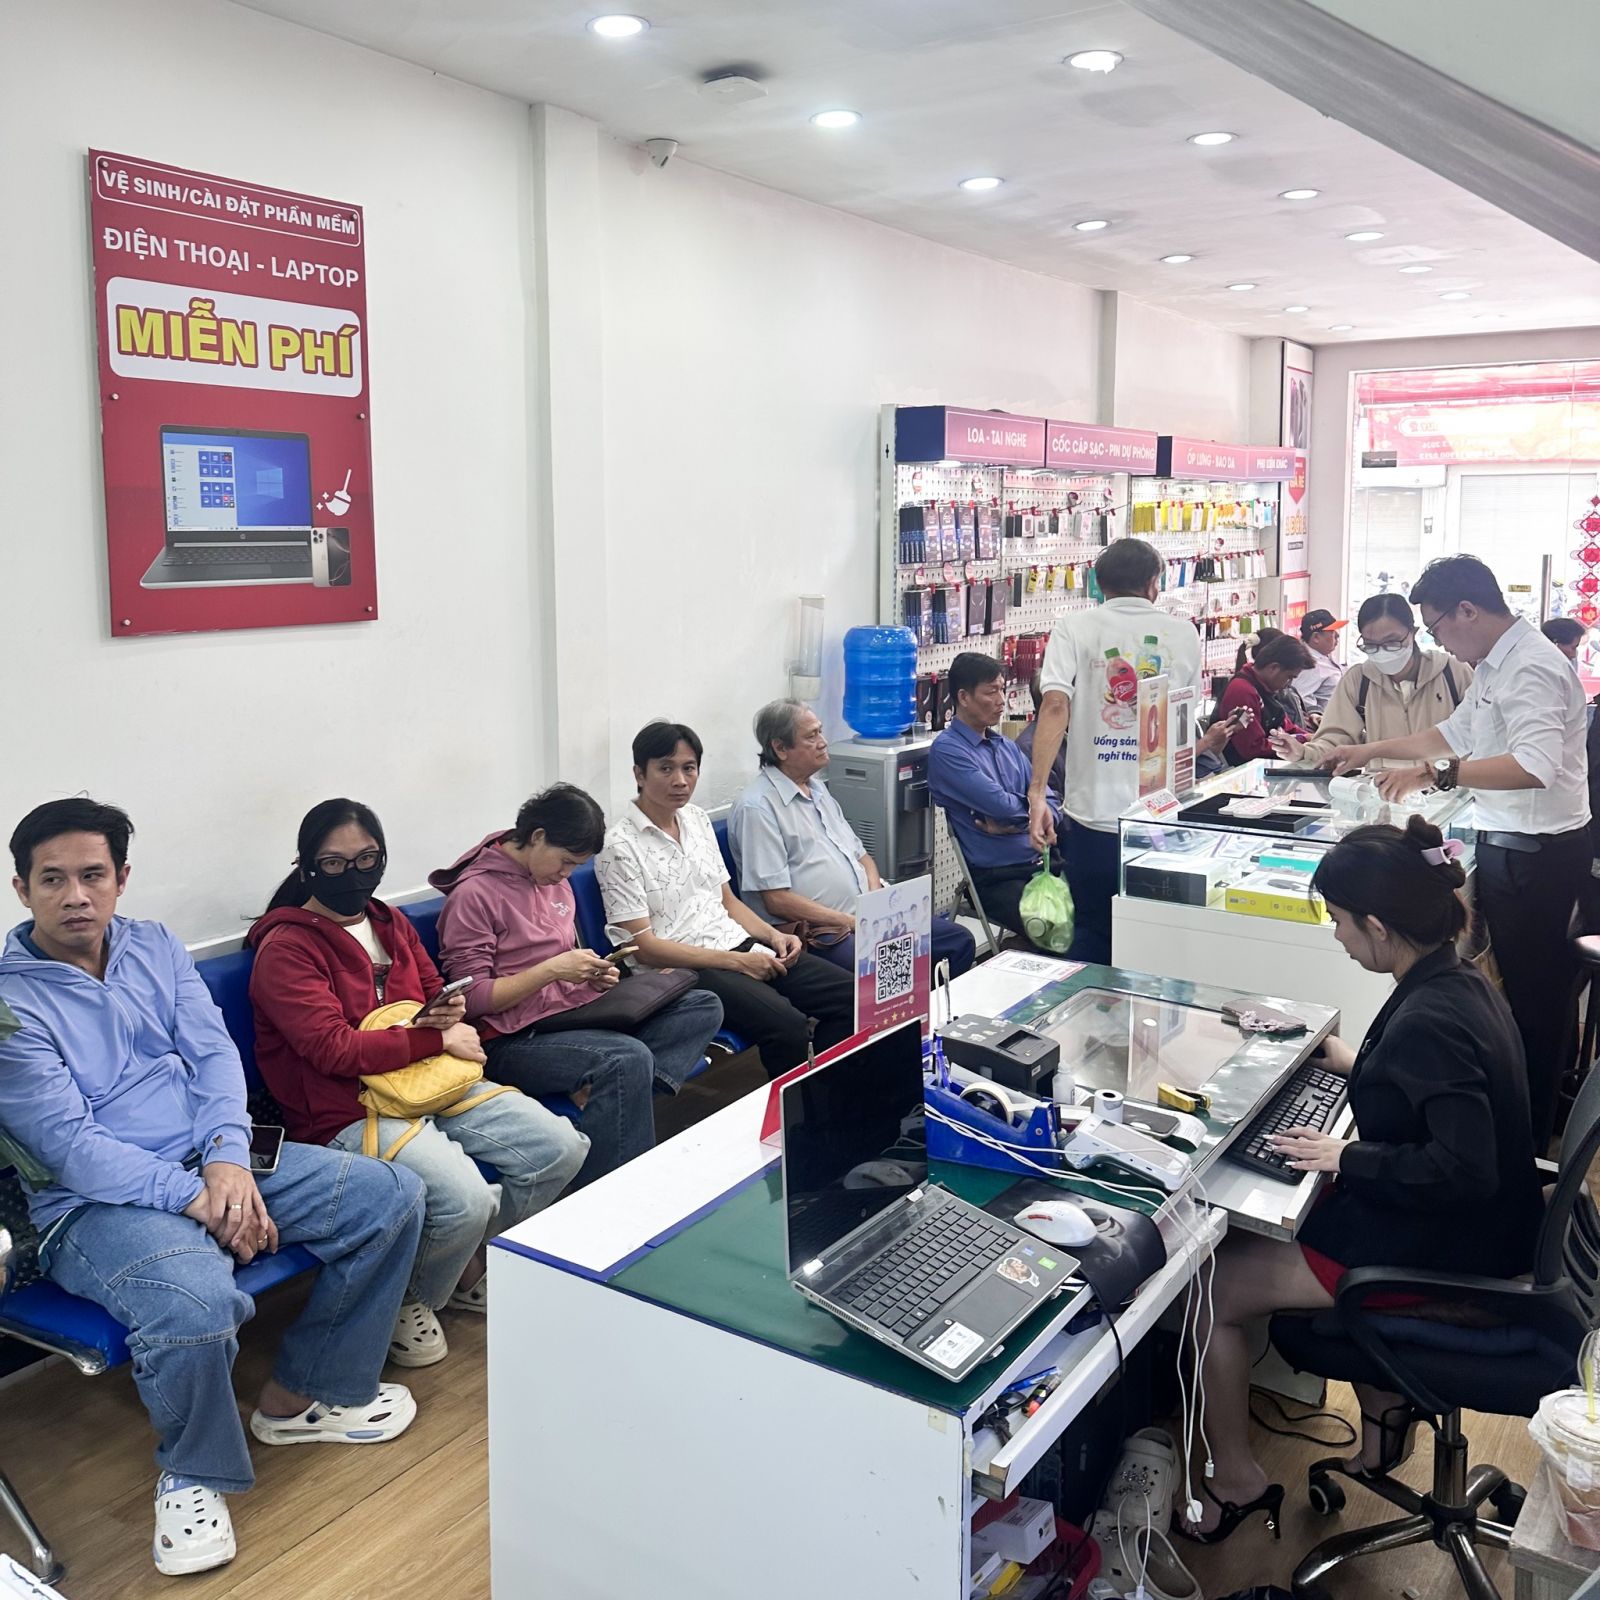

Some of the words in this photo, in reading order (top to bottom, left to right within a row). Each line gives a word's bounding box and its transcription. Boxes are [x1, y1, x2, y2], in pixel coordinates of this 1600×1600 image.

[101, 169, 130, 195] VỆ
[133, 176, 222, 210] SINH/CÀI
[225, 195, 261, 219] ĐẶT
[264, 201, 313, 228] PHẦN
[316, 212, 356, 235] MỀM
[103, 226, 168, 261] ĐIỆN
[173, 239, 250, 275] THOẠI
[270, 256, 360, 289] LAPTOP
[115, 296, 259, 370] MIỄN
[267, 323, 360, 379] PHÍ
[967, 427, 985, 444] LOA
[991, 430, 1003, 446] TAI
[1005, 431, 1028, 448] NGHE
[1052, 433, 1071, 452] CỐC
[1072, 437, 1089, 454] CÁP
[1089, 441, 1105, 459] SẠC
[1109, 443, 1121, 457] PIN
[1093, 734, 1118, 748] Uống
[1119, 735, 1137, 746] sản
[1097, 751, 1121, 763] nghĩ
[1121, 751, 1137, 761] tho
